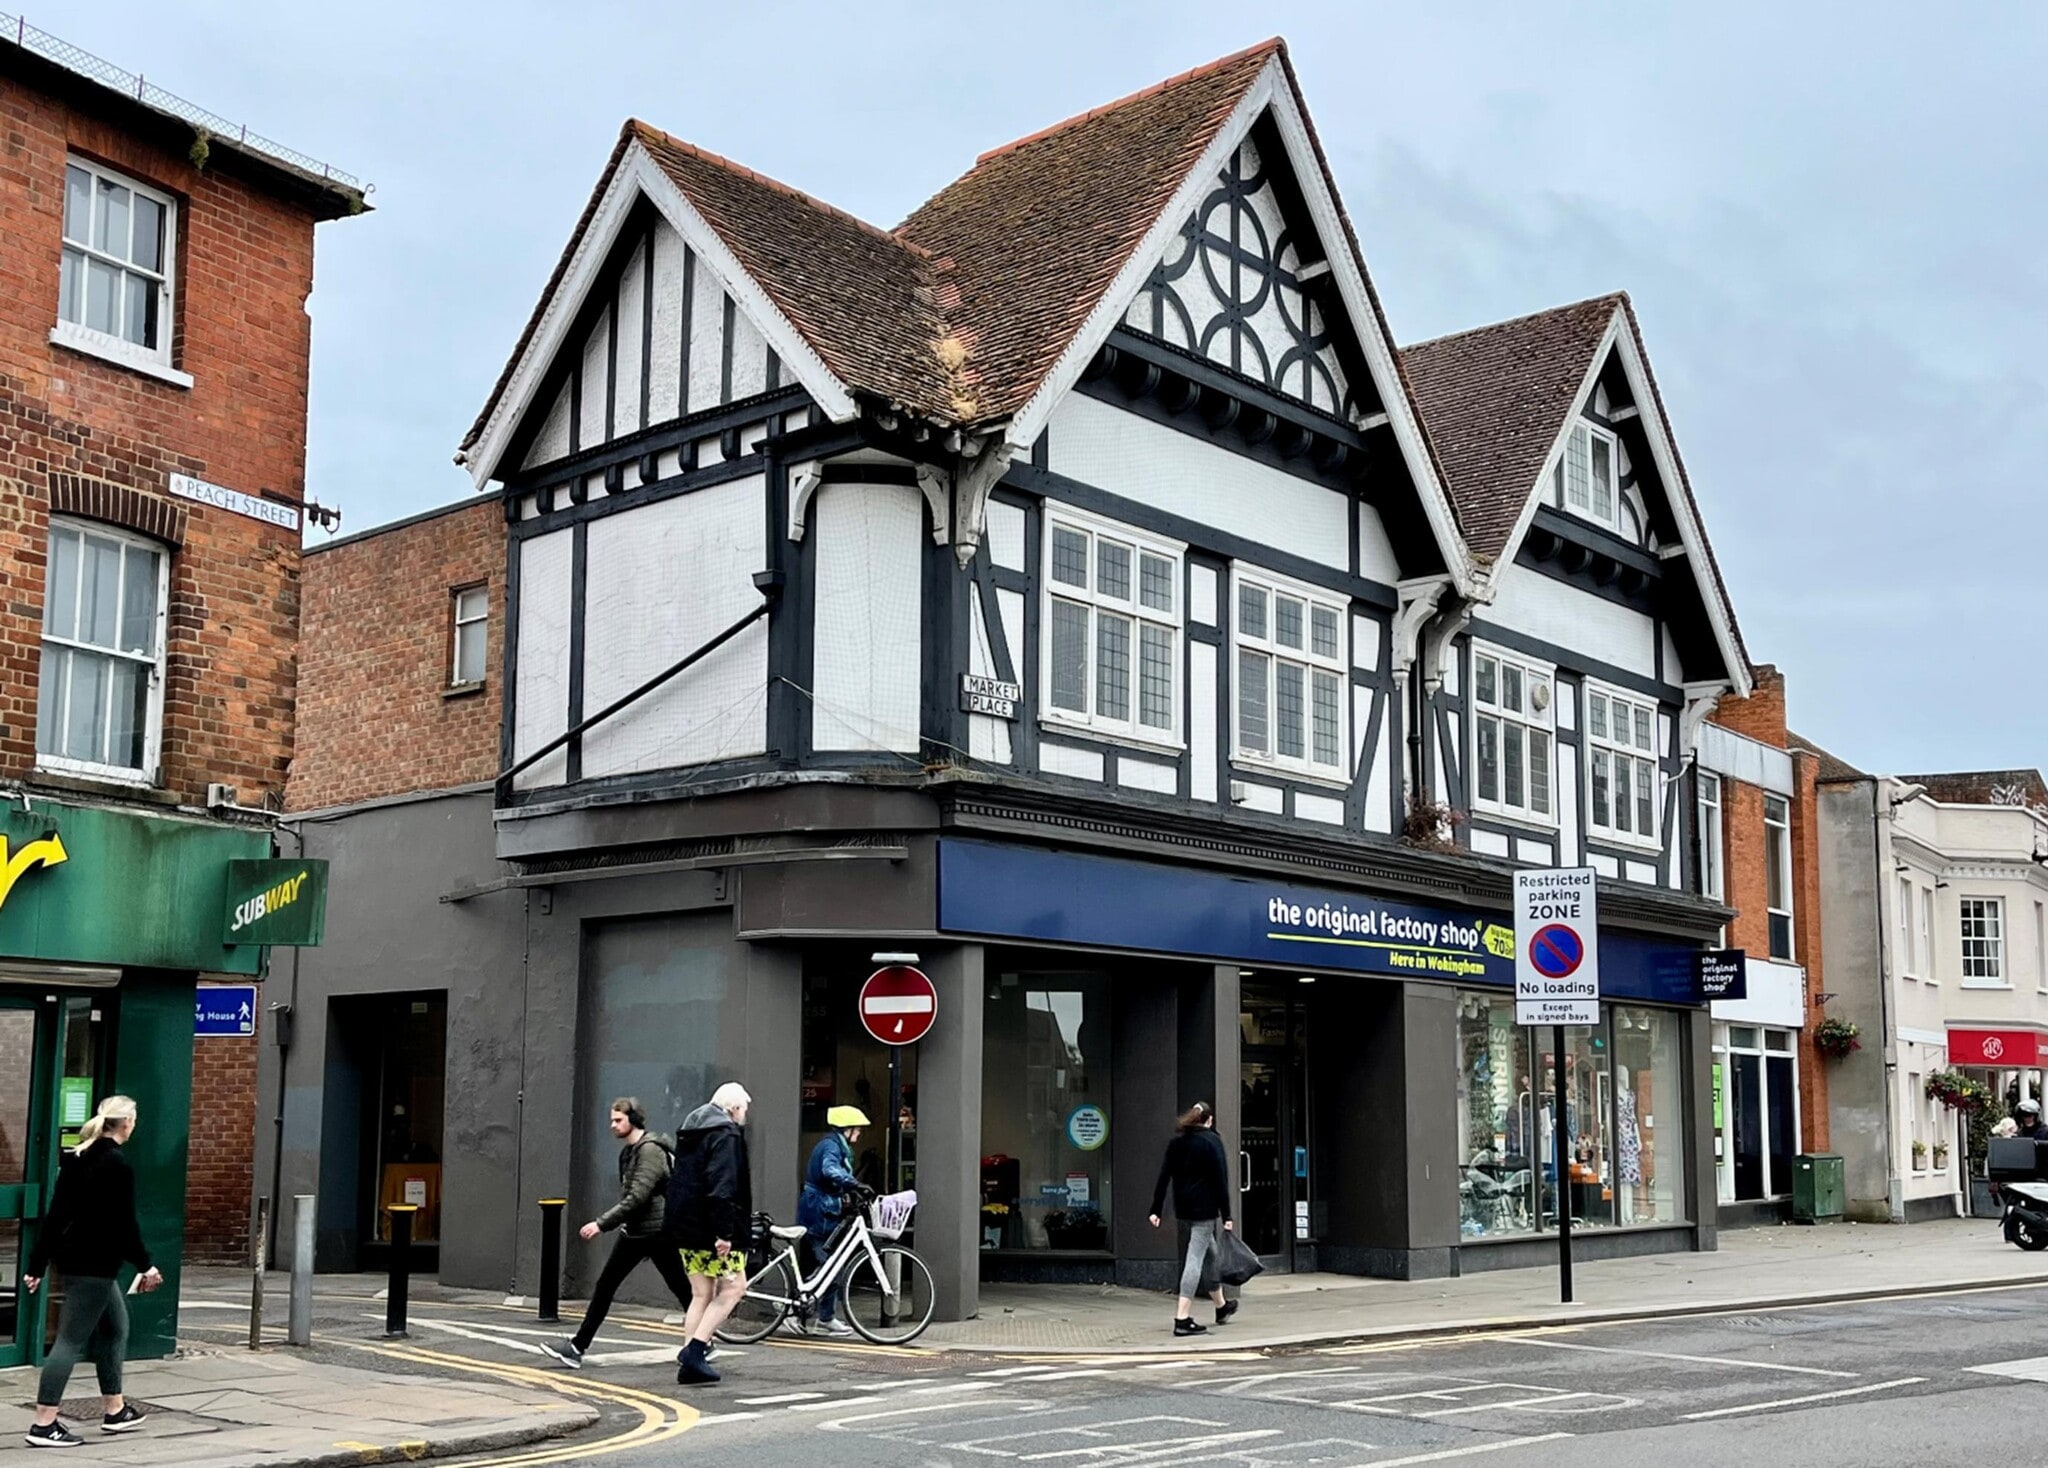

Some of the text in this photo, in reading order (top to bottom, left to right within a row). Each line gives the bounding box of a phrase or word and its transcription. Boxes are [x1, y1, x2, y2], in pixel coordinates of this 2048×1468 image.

[187, 480, 296, 526] PEACH STREET
[969, 678, 1017, 698] MARKET
[972, 696, 1008, 715] PLACE
[1519, 873, 1590, 887] Restricted
[231, 871, 307, 931] SUBWAY
[1529, 889, 1580, 903] parking
[1529, 904, 1581, 919] ZONE
[1268, 897, 1479, 951] the original factory shop
[1390, 951, 1485, 976] Here in Wokingham
[1702, 964, 1738, 974] original
[1702, 974, 1733, 983] factory
[1520, 982, 1595, 995] No loading
[1703, 984, 1726, 992] shop
[1543, 1003, 1573, 1012] Except
[208, 1012, 236, 1021] House
[1538, 1013, 1566, 1021] signed
[1568, 1013, 1589, 1021] bays
[1493, 1027, 1509, 1124] SPRING
[1170, 1366, 1646, 1419] KEEP
